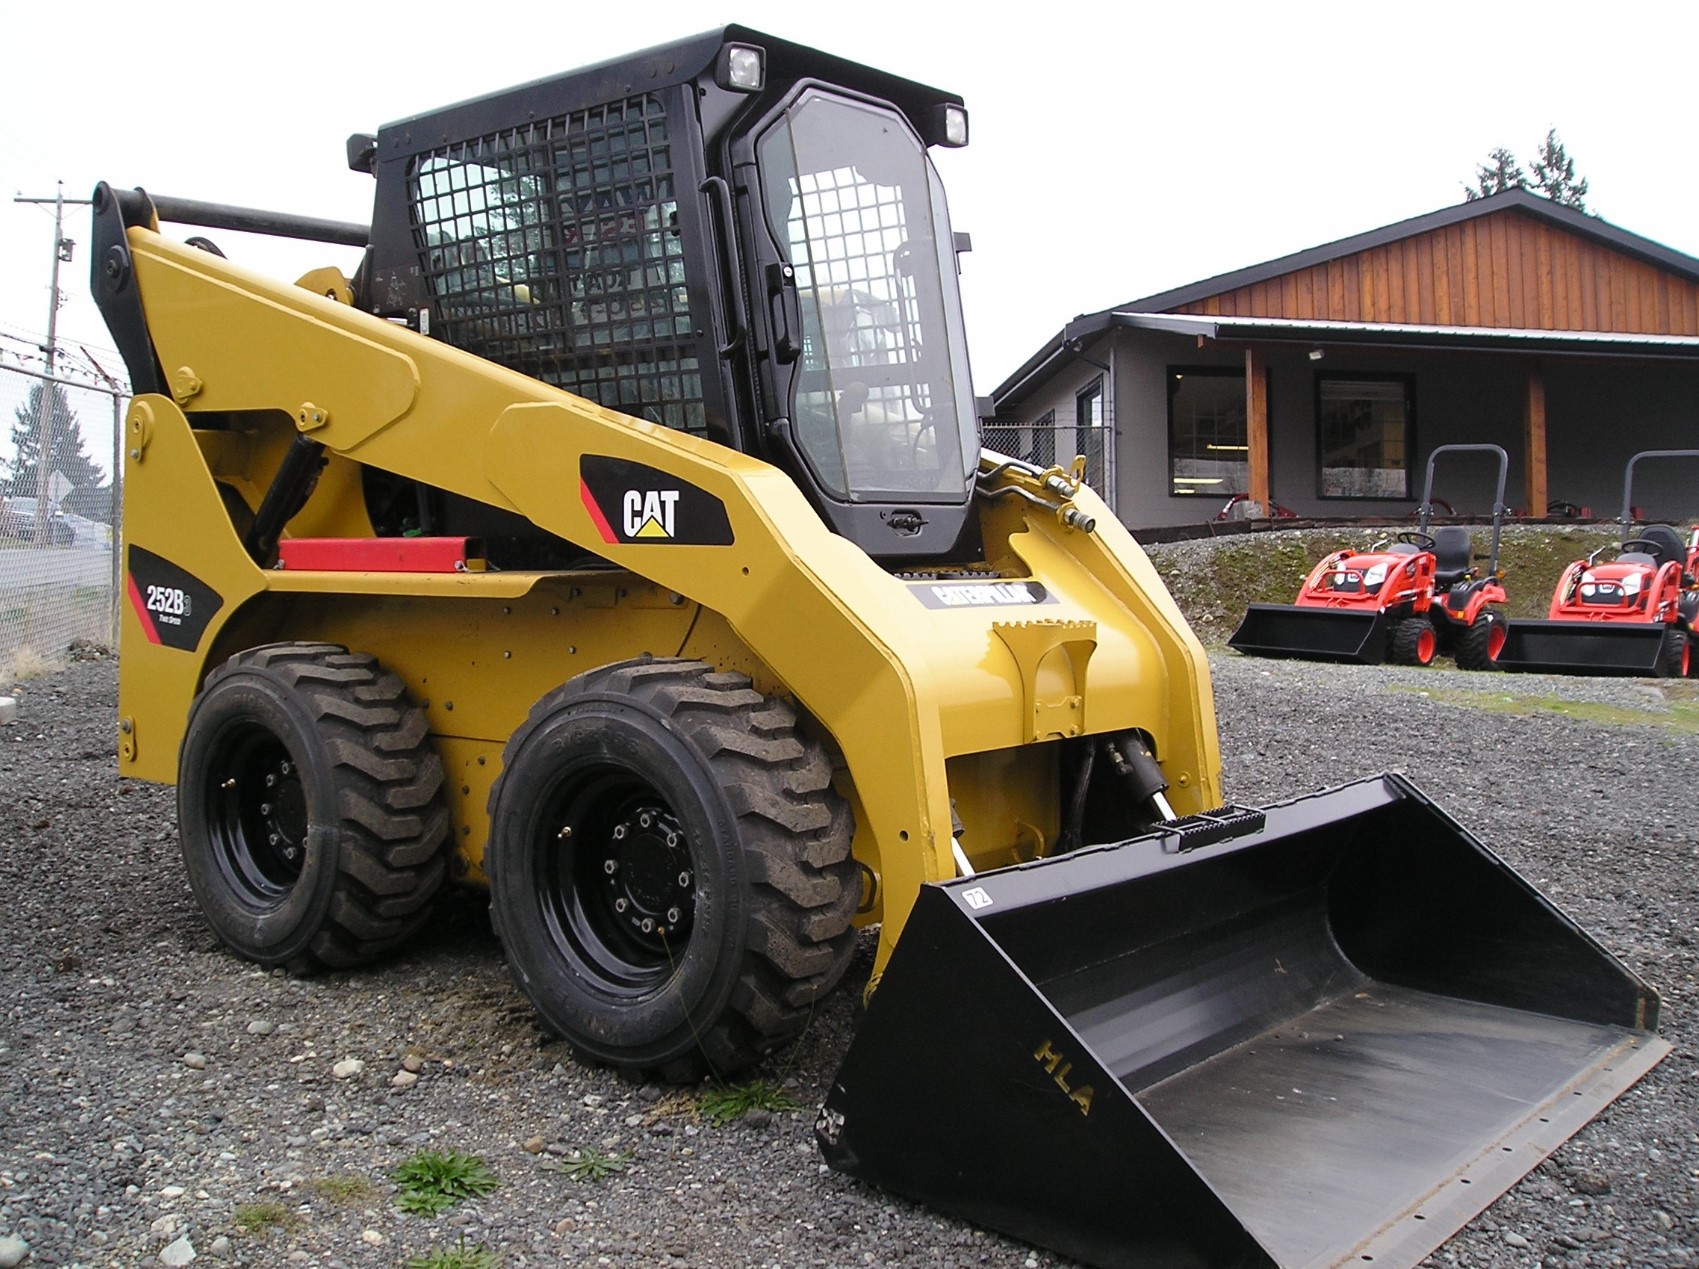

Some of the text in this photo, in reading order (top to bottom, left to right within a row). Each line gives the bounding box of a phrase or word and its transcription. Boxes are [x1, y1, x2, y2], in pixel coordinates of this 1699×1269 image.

[623, 490, 680, 538] CAT
[966, 890, 989, 906] 72
[1033, 1040, 1094, 1117] HLA
